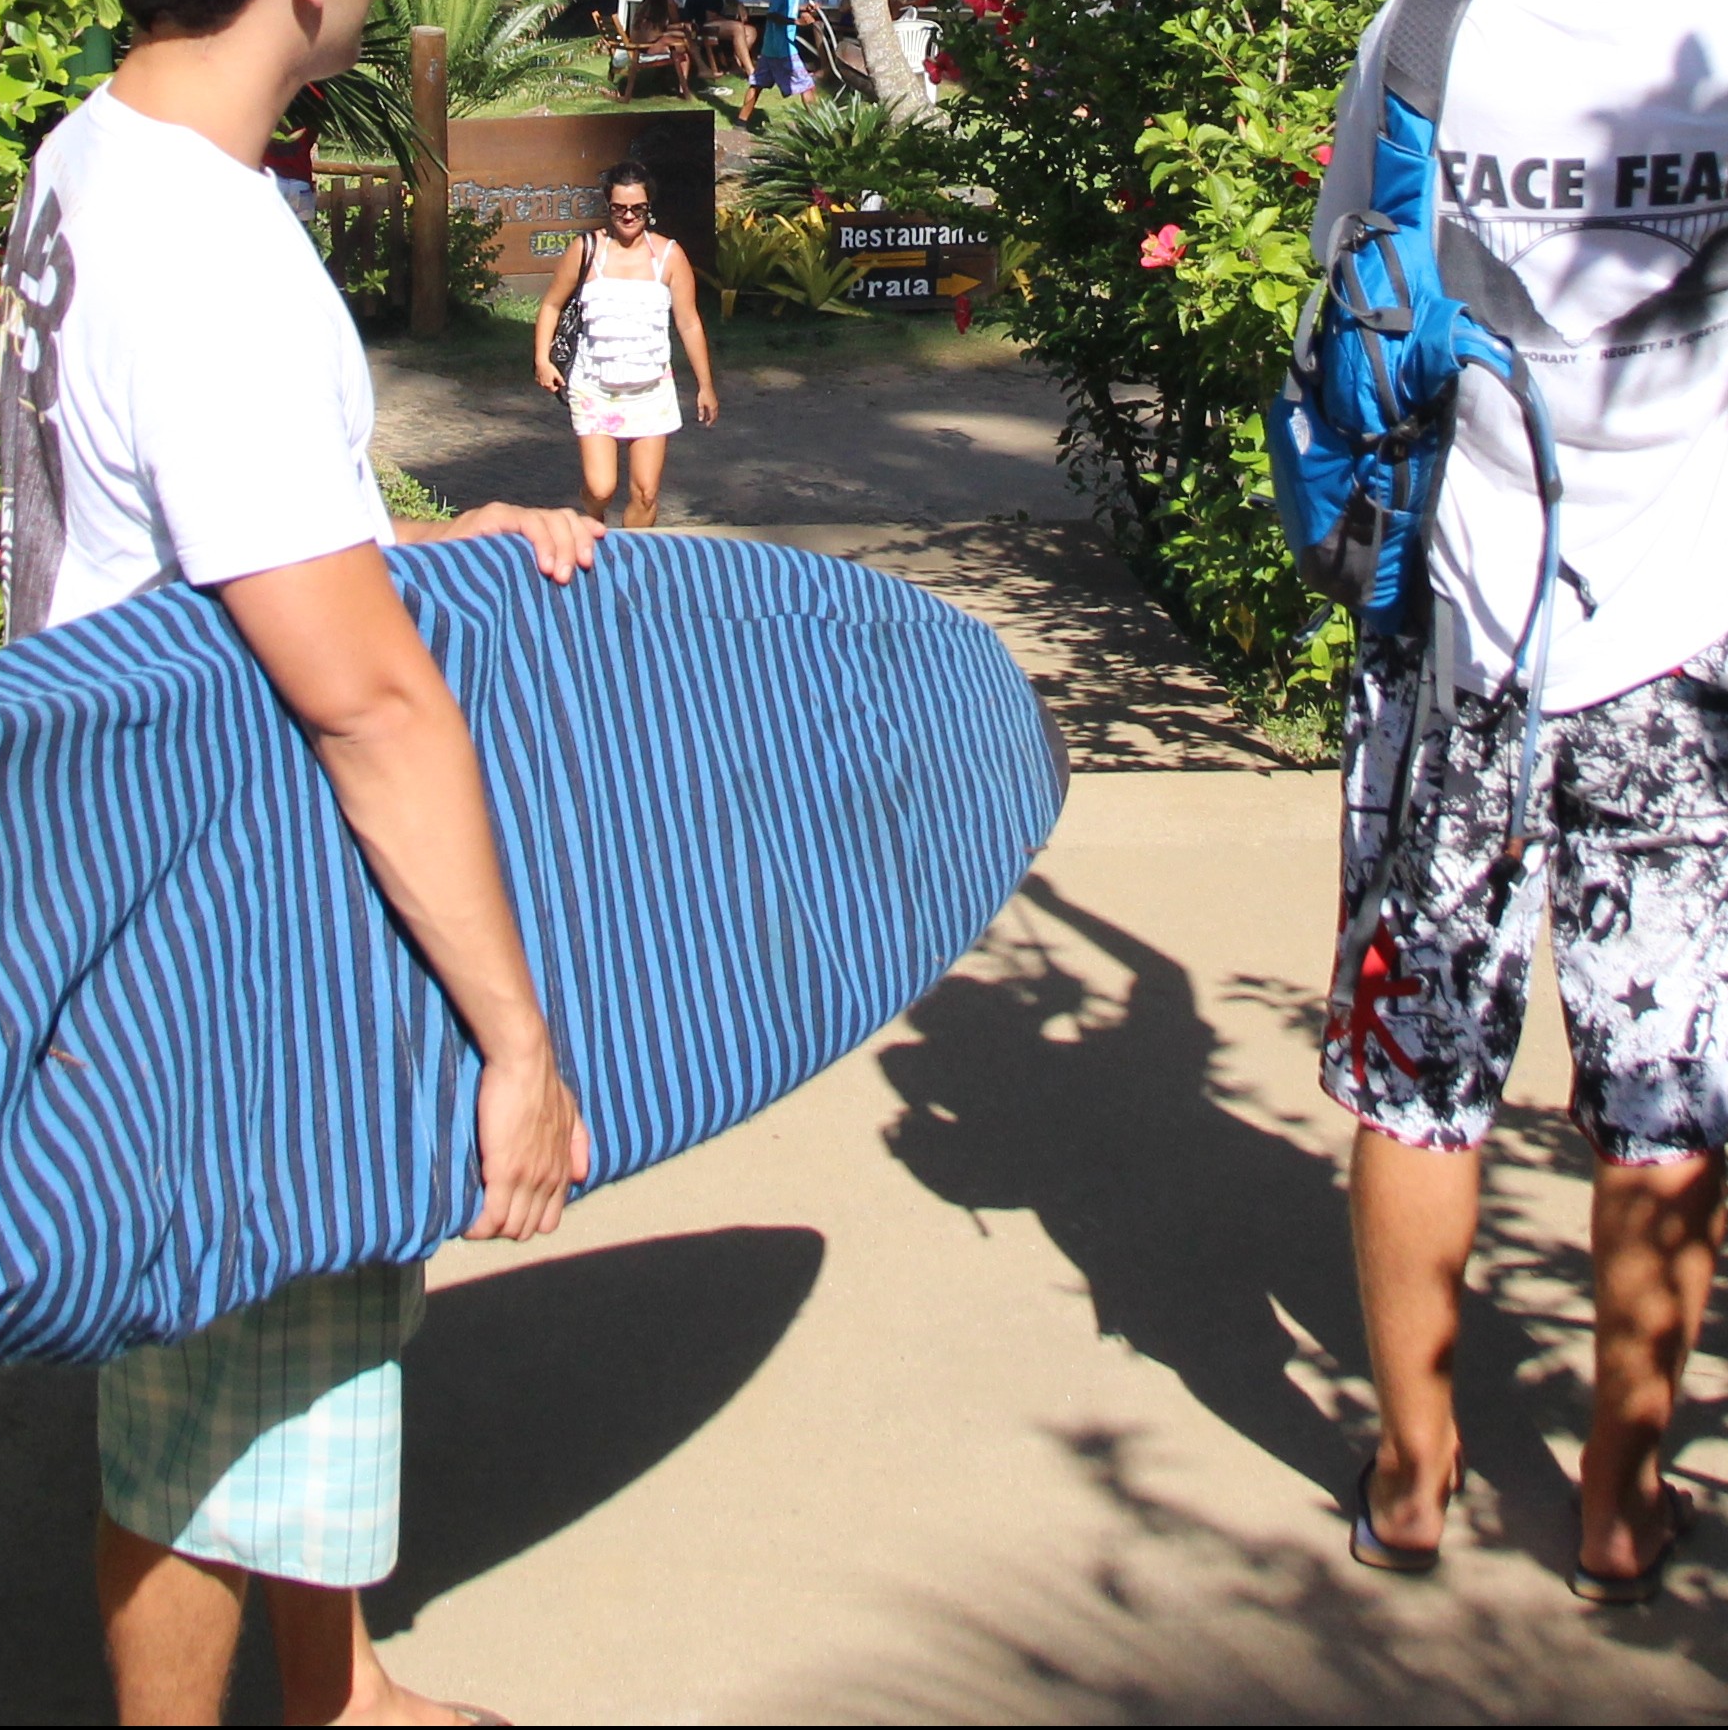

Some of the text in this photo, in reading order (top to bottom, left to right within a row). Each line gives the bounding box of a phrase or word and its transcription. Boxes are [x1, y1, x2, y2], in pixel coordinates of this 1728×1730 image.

[1438, 149, 1587, 209] FACE
[1599, 342, 1657, 360] REGRET
[1659, 339, 1674, 350] IS
